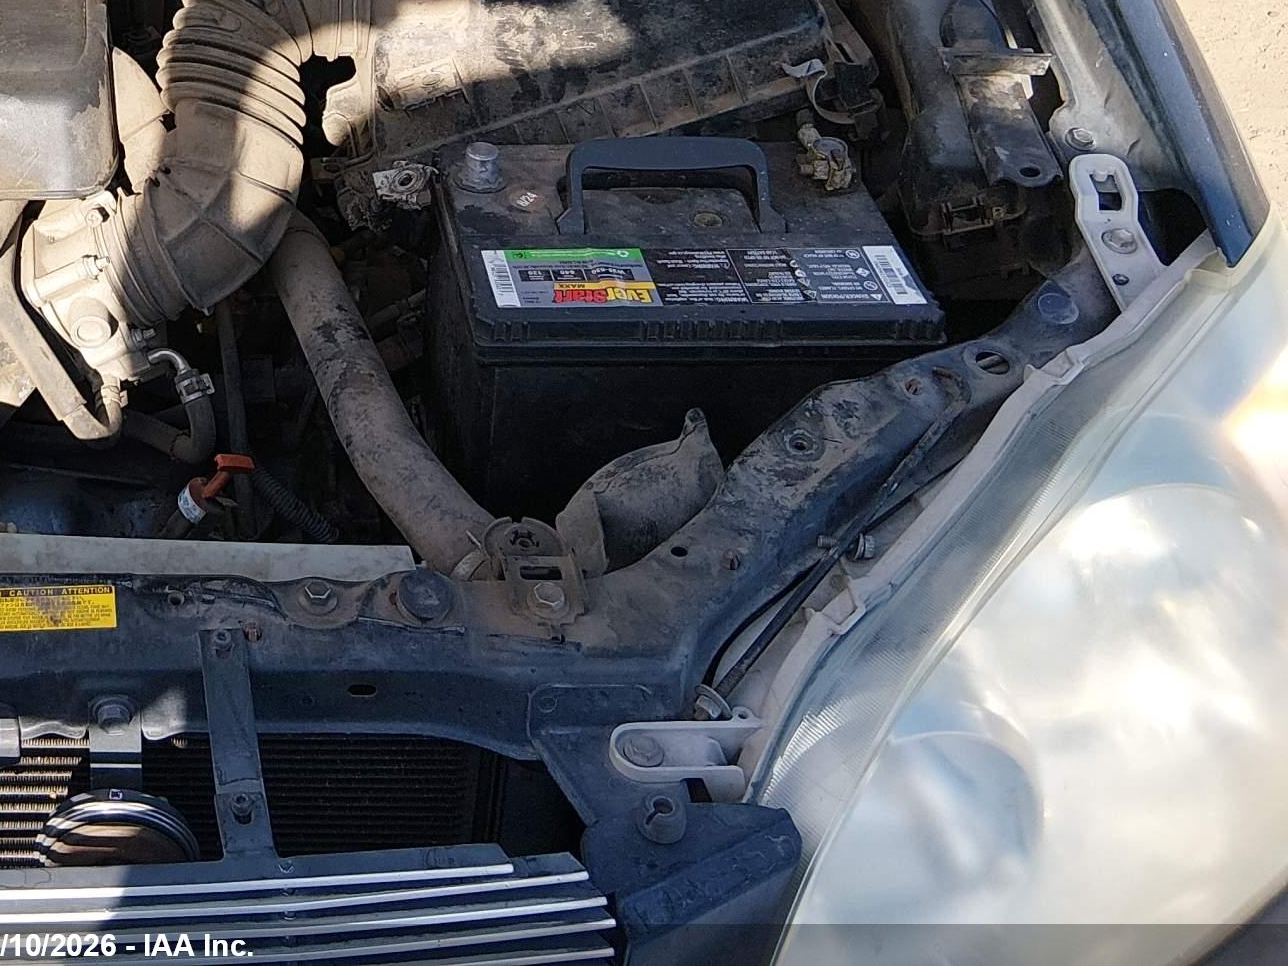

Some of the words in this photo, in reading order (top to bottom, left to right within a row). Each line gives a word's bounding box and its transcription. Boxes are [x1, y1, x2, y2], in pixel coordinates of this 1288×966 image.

[554, 287, 653, 303] EverStart
[9, 589, 54, 597] CAUTION
[61, 586, 111, 595] ATTENTION
